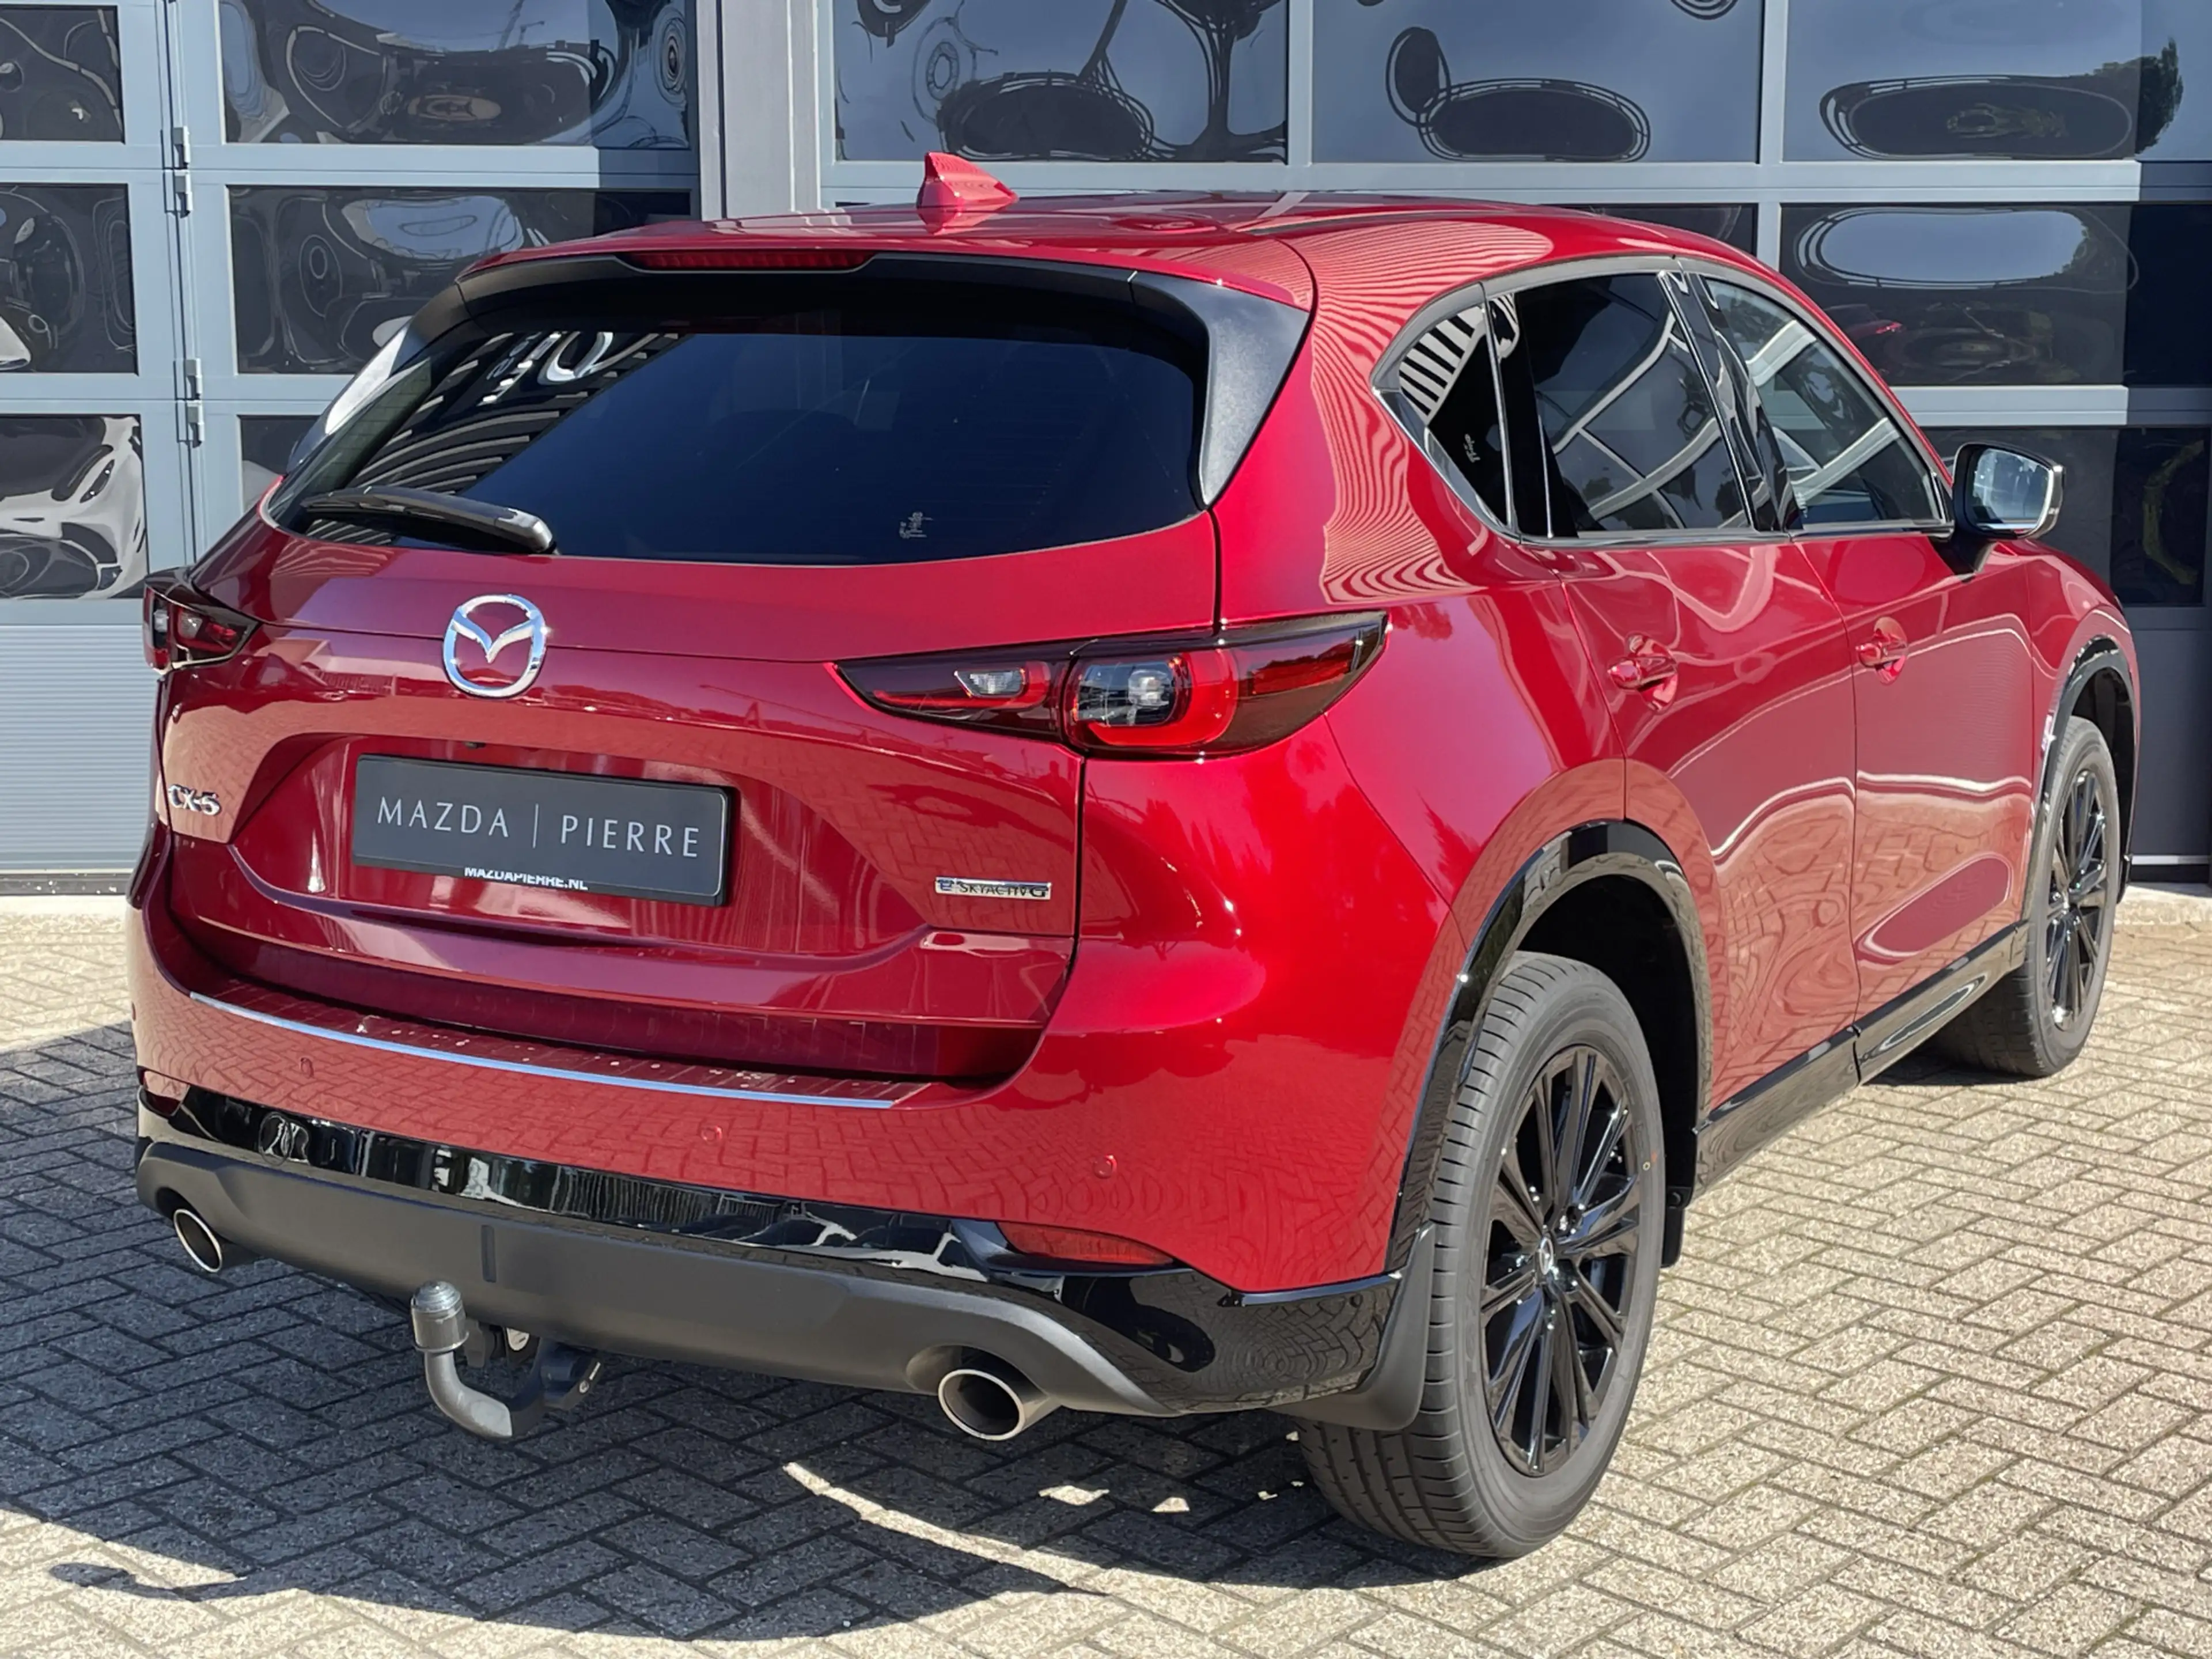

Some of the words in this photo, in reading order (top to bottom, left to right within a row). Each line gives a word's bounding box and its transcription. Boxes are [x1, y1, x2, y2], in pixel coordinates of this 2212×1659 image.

[168, 783, 221, 816] CX-5
[377, 796, 509, 838] MAZDA
[560, 815, 699, 857] PIERRE
[464, 866, 589, 891] MAZDAPIERRE.NL
